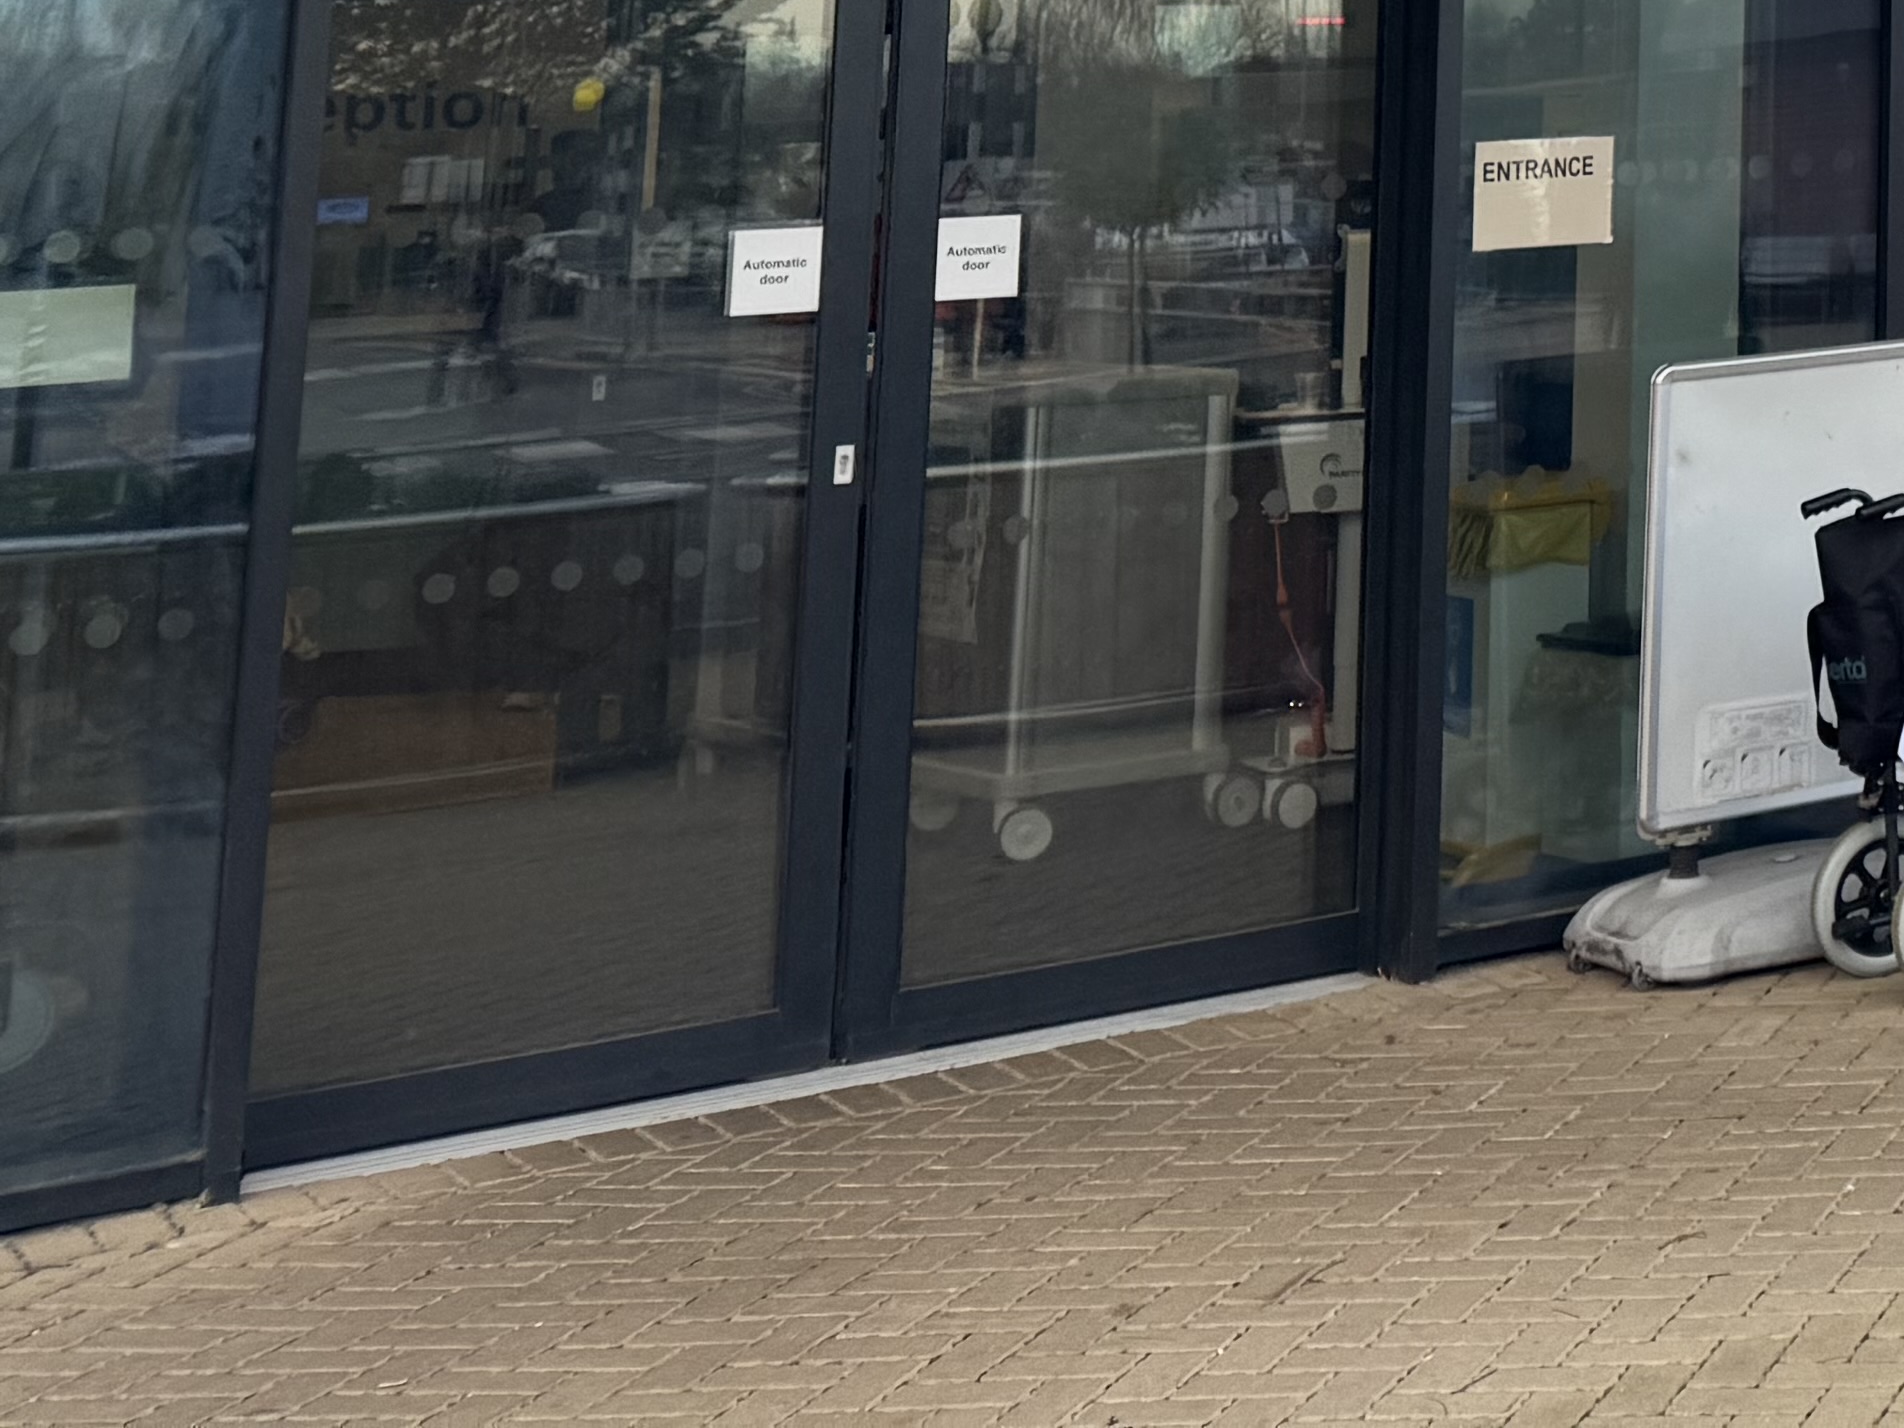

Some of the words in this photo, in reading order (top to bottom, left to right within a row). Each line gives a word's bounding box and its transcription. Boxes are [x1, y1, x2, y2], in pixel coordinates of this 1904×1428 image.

[1483, 155, 1594, 183] ENTRANCE
[946, 245, 1007, 257] Automatic
[743, 258, 807, 271] Automatic
[962, 261, 990, 271] door
[760, 274, 789, 285] door
